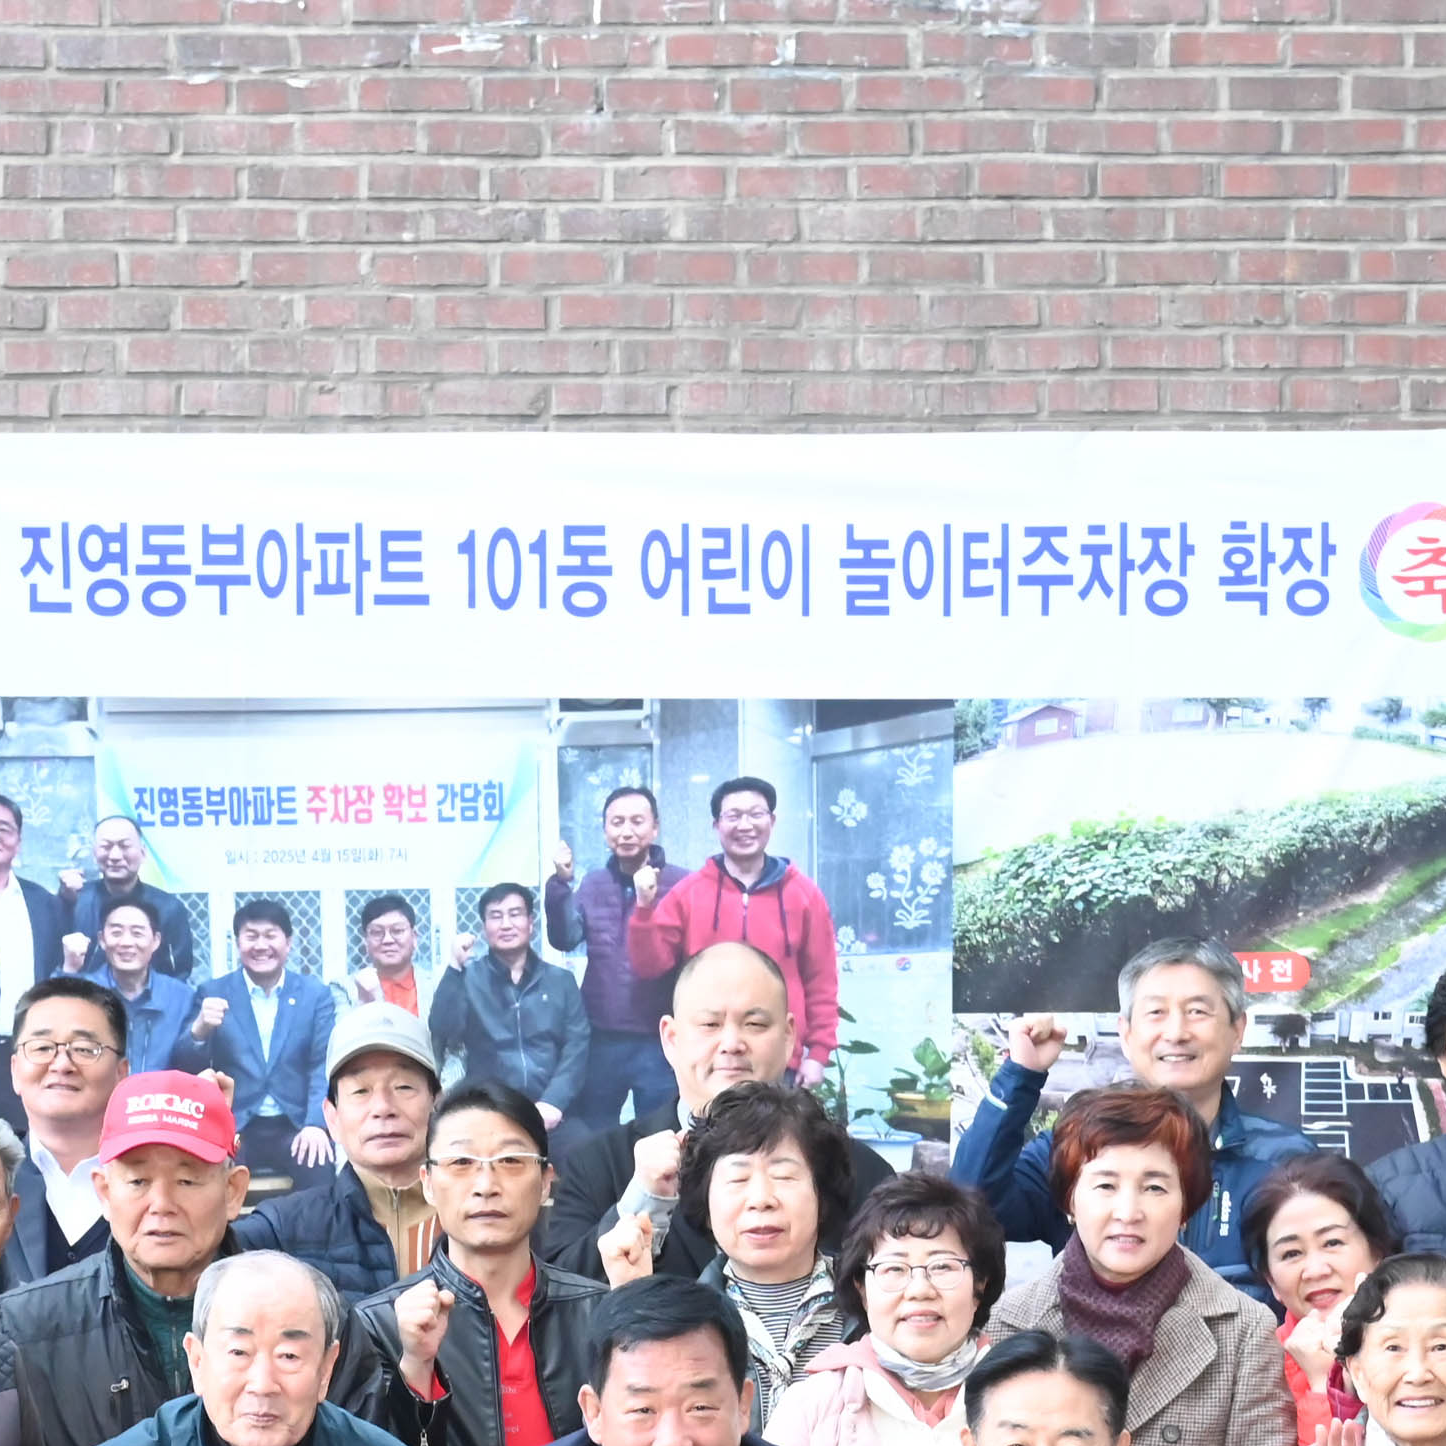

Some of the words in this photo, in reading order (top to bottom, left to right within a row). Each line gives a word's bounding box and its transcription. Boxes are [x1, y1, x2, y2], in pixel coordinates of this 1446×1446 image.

[19, 522, 430, 618] 진영동부아파트
[458, 524, 613, 618] 101동
[641, 522, 810, 617] 어린이
[839, 521, 1196, 618] 놀이터주차장
[1218, 520, 1337, 617] 확장
[133, 786, 298, 827] 진영동부아파트
[306, 784, 375, 825] 주차장
[383, 783, 428, 823] 확보
[436, 780, 506, 823] 간담회
[262, 849, 306, 864] 2025년
